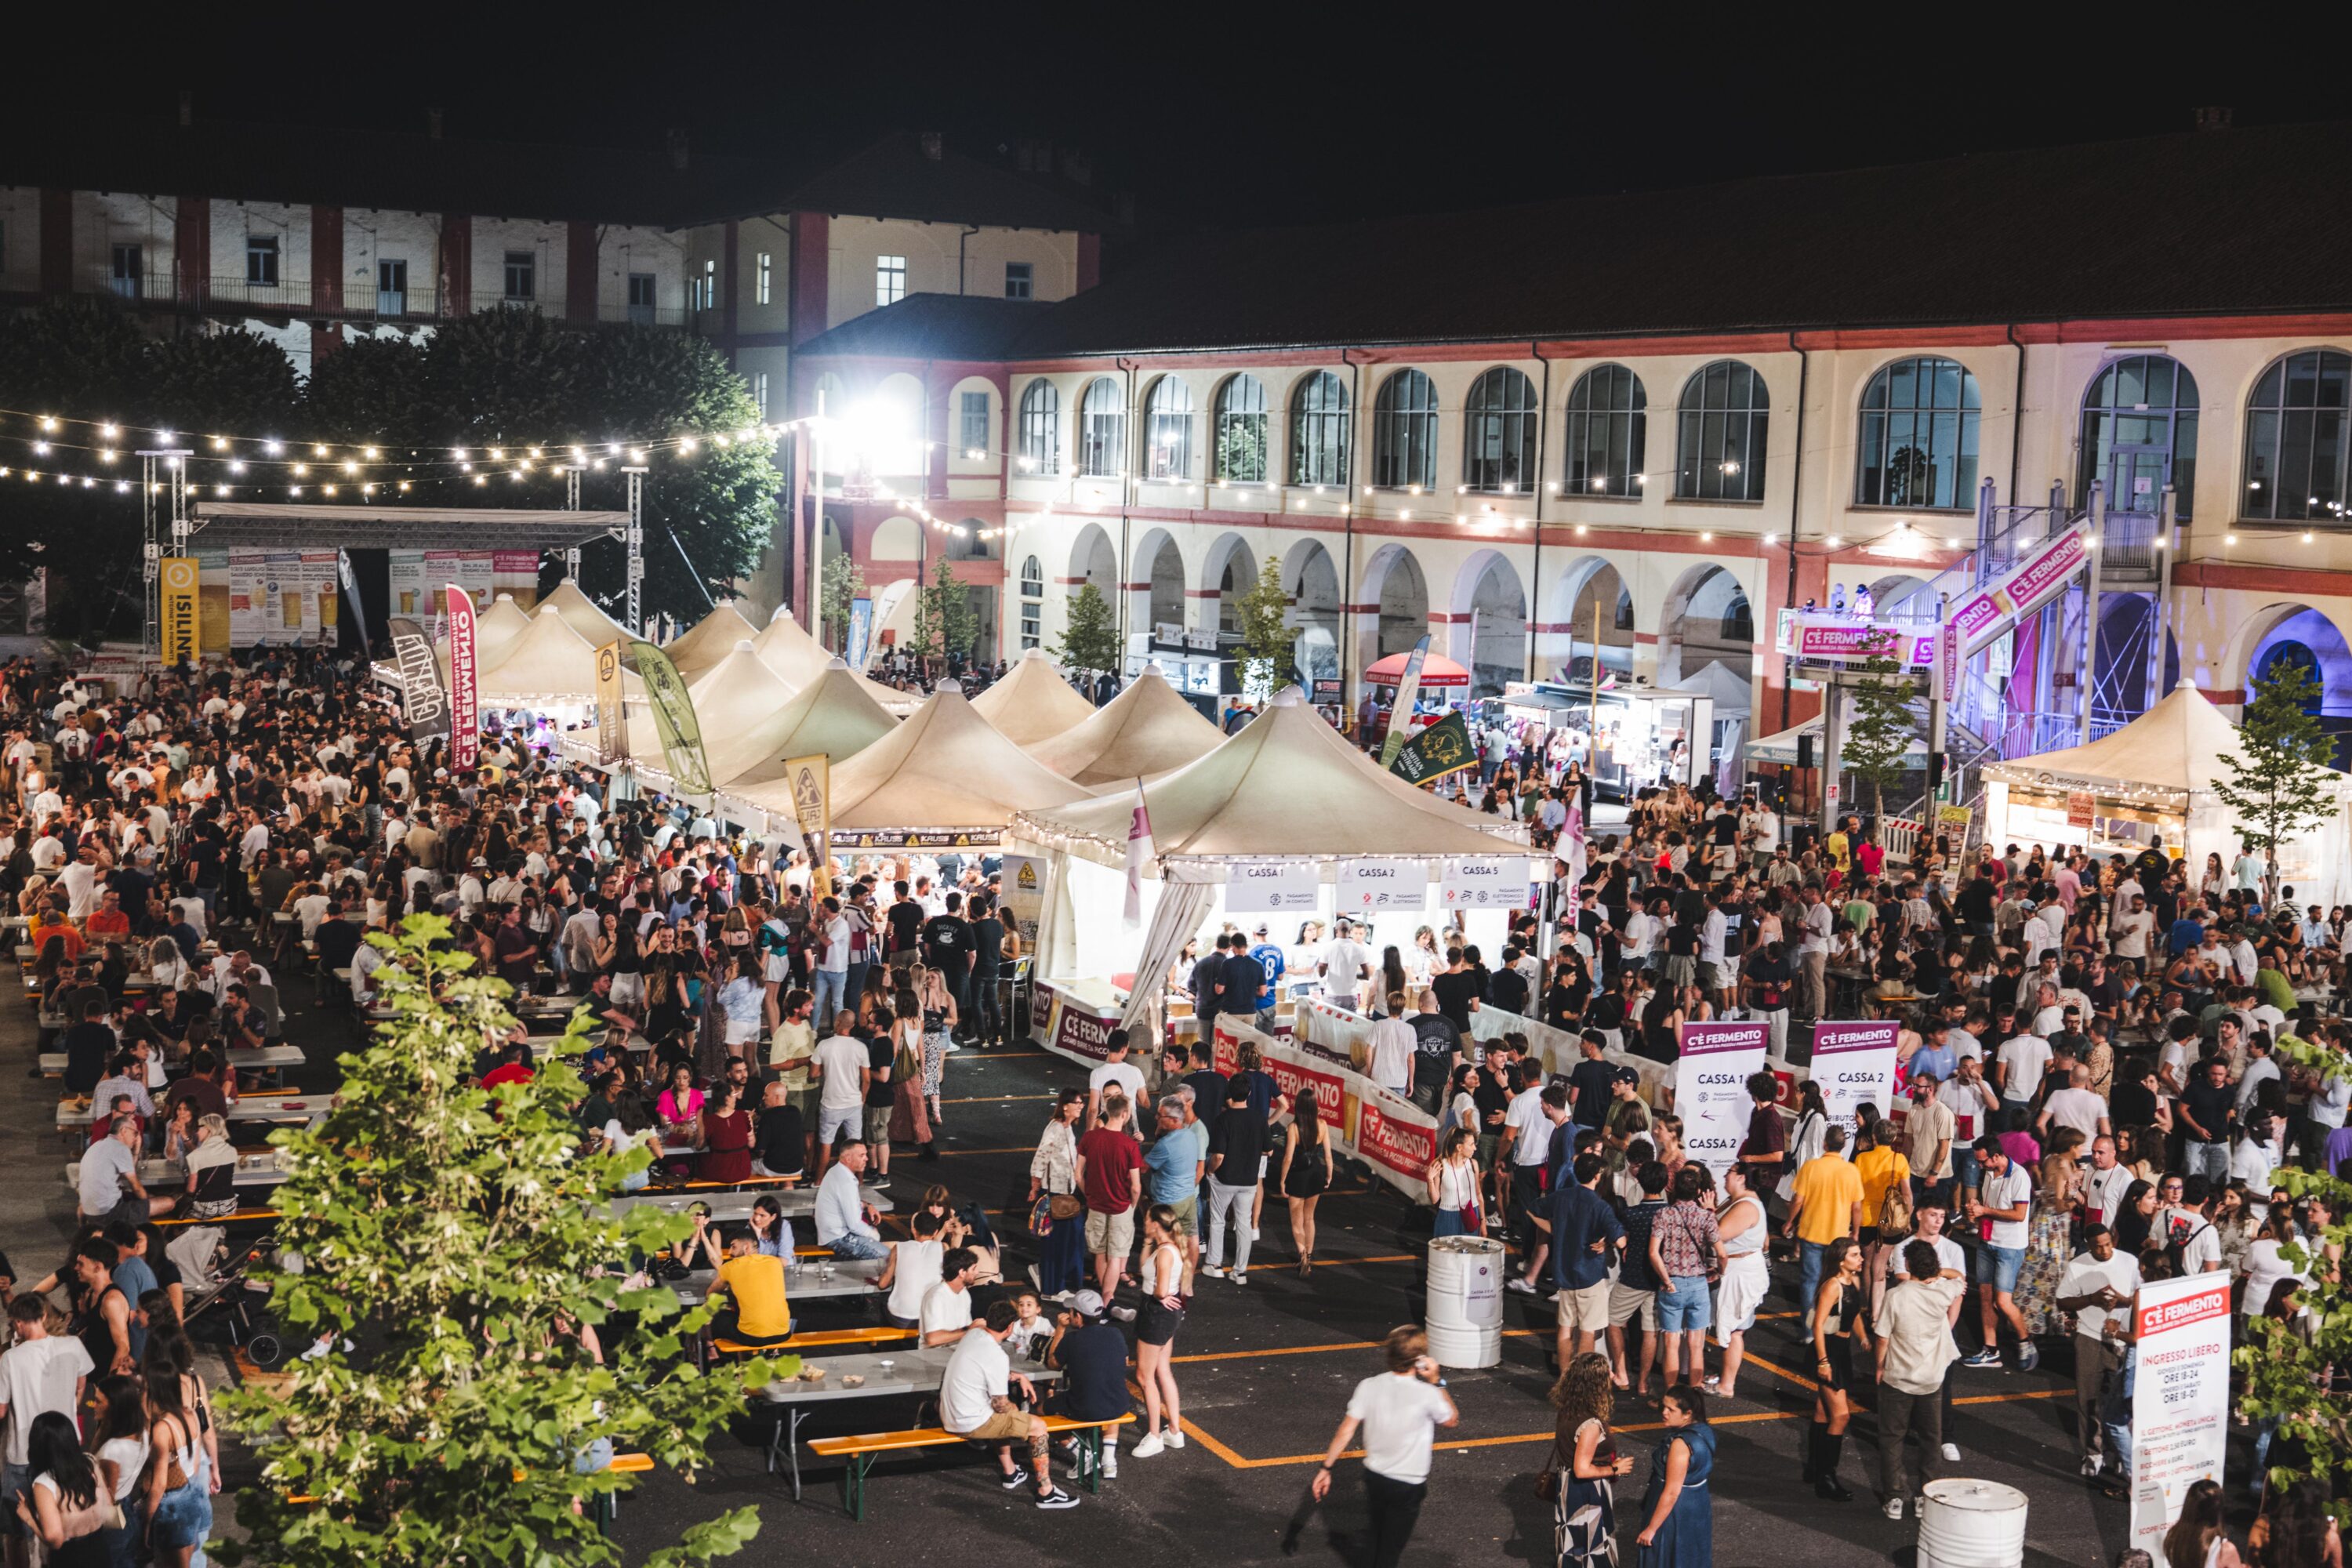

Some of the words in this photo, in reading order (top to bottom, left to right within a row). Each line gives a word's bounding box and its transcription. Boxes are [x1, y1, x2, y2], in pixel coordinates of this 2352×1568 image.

[2012, 577, 2032, 597] C'È
[2029, 537, 2081, 584] FERMENTO
[1806, 628, 1822, 644] C'È
[1399, 747, 1421, 779] CONTRARIO
[1406, 746, 1425, 771] BASTIAN
[2071, 805, 2092, 815] TACOS
[1247, 869, 1277, 877] CASSA
[1359, 869, 1388, 877] CASSA
[1462, 866, 1490, 875] CASSA
[1492, 866, 1498, 875] 5
[1265, 957, 1276, 981] 8
[1065, 1011, 1080, 1036] C'È
[1080, 1019, 1113, 1045] FERM
[1687, 1033, 1705, 1047] C'È
[1706, 1029, 1762, 1044] FERMENTO
[1820, 1032, 1838, 1046] C'È
[1838, 1029, 1893, 1044] FERMENTO
[1094, 1046, 1109, 1055] PICCO
[1698, 1074, 1736, 1084] CASSA
[1738, 1074, 1744, 1084] 1
[1838, 1073, 1875, 1083] CASSA
[1878, 1073, 1884, 1083] 2
[1276, 1069, 1340, 1108] FERMENTO
[1364, 1109, 1380, 1139] C'È
[1377, 1120, 1431, 1160] FERMENTO
[1690, 1139, 1727, 1149] CASSA
[1730, 1138, 1737, 1149] 2
[2144, 1305, 2163, 1327] C'È
[2164, 1293, 2223, 1322] FERMENTO
[2142, 1348, 2187, 1367] INGRESSO
[2188, 1343, 2220, 1358] LIBERO
[2180, 1360, 2205, 1370] DOMENICA
[2163, 1372, 2179, 1385] ORE
[2181, 1369, 2198, 1381] 18-24
[2183, 1381, 2201, 1389] SABATO
[2163, 1392, 2179, 1404] ORE
[2181, 1389, 2198, 1399] 18-01
[2175, 1420, 2197, 1430] MONETA
[2143, 1446, 2169, 1456] GETTONE
[2180, 1439, 2196, 1449] EURO
[2140, 1459, 2167, 1470] BICCHIERE
[2172, 1454, 2184, 1463] EURO
[2140, 1471, 2167, 1483] BICCHIERE
